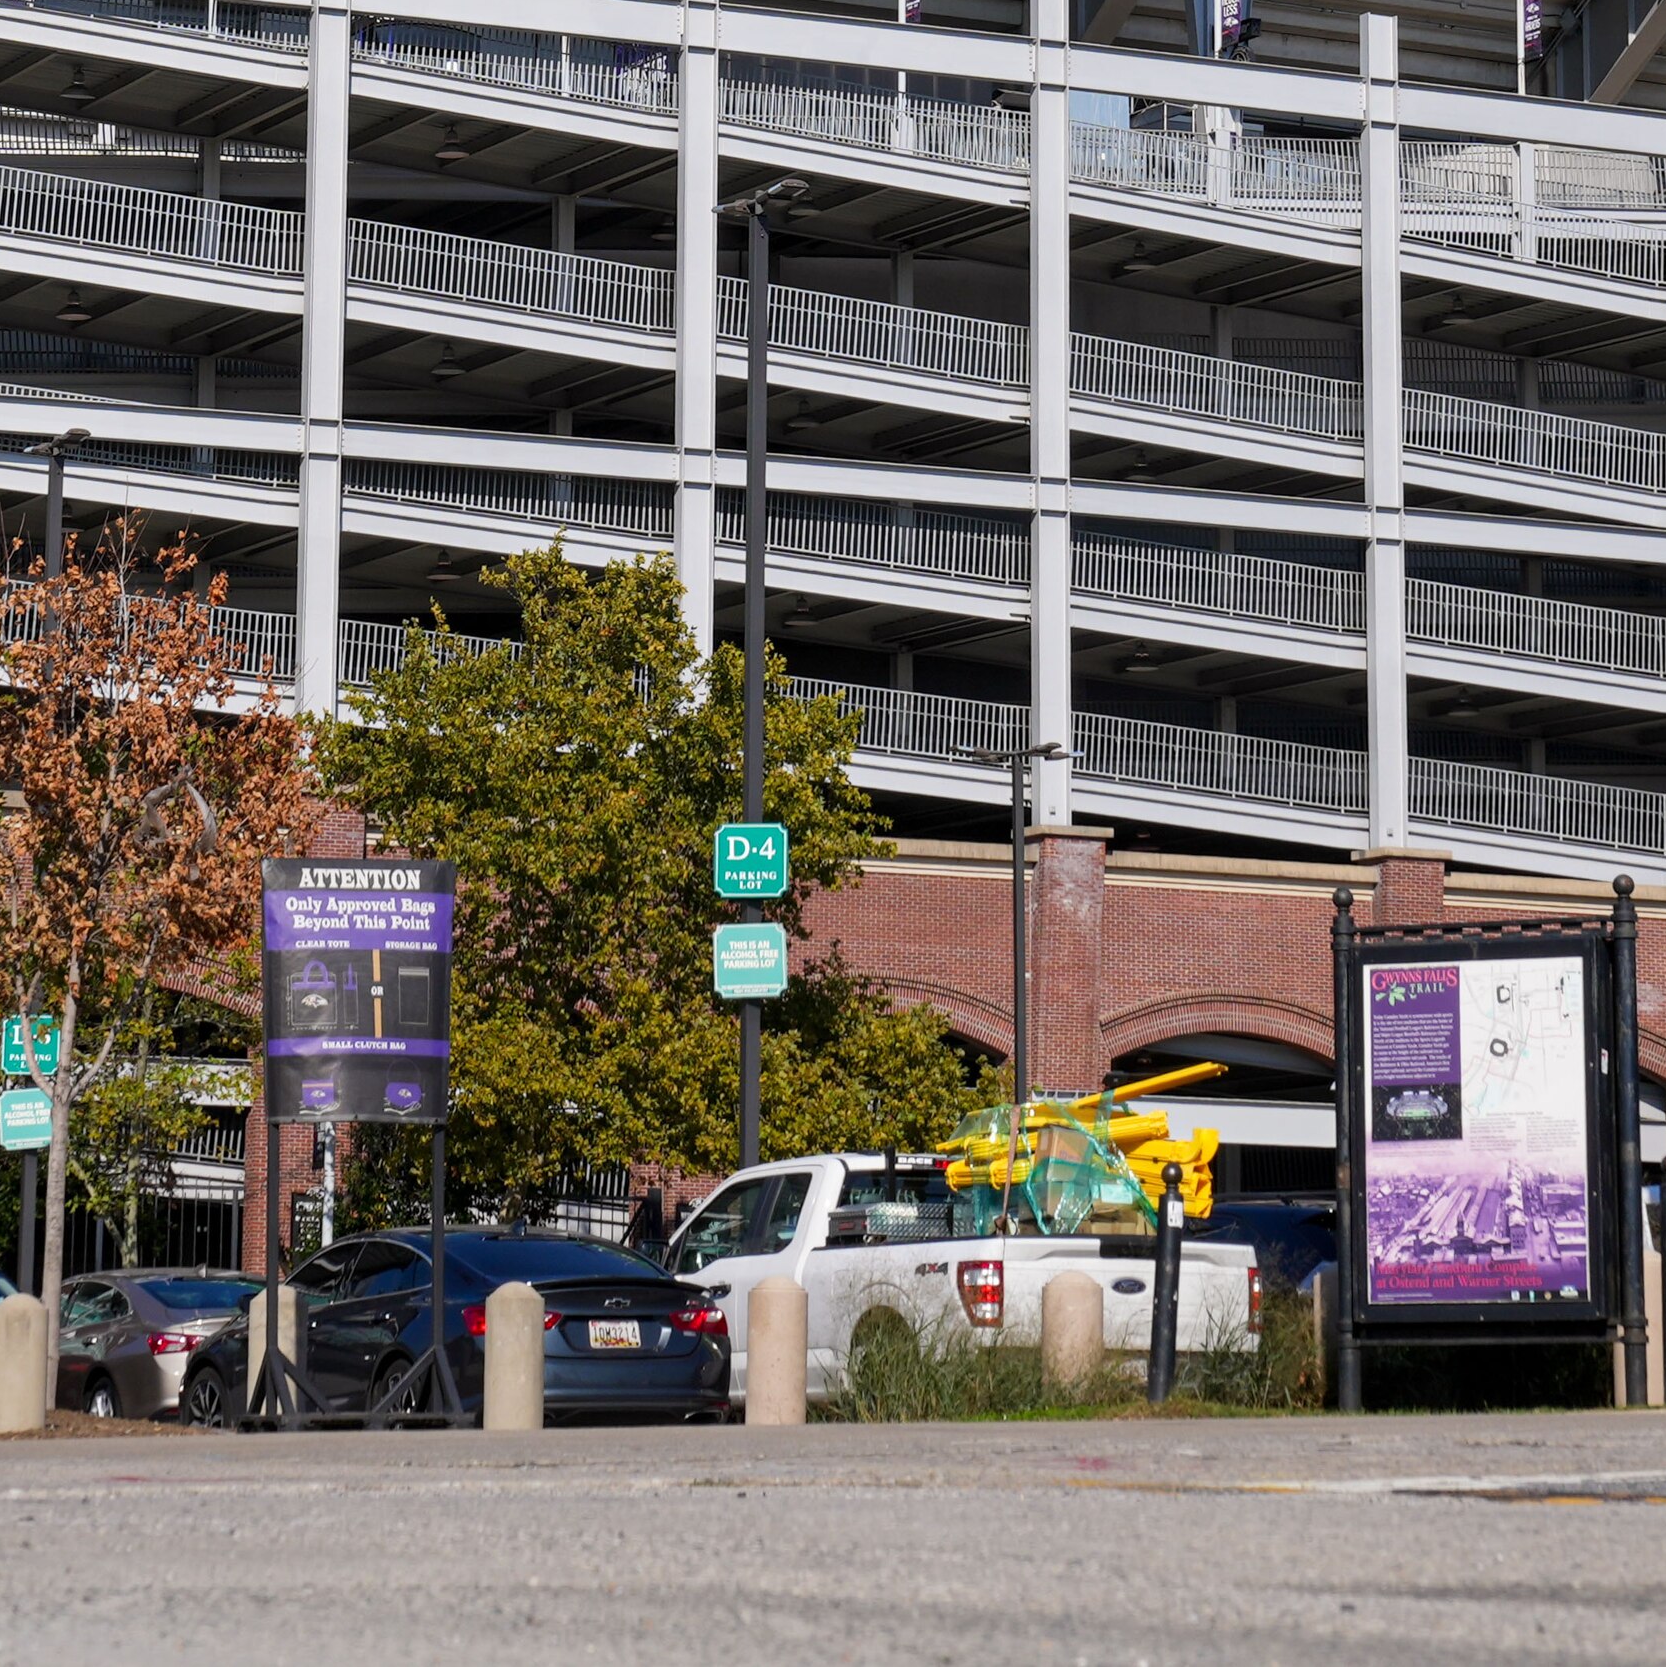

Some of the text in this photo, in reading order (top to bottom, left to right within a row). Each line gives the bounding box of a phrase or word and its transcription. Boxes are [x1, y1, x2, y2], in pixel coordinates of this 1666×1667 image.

[299, 867, 421, 890] ATTENTION
[724, 871, 777, 881] PARKING
[739, 881, 762, 890] LOT
[285, 897, 436, 915] Only Approved Bags
[293, 914, 430, 931] Beyond This Point
[295, 940, 350, 949] CLEAR TOTE
[385, 940, 438, 951] STORAGE BAG
[729, 940, 770, 950] THIS IS AN
[721, 949, 779, 960] ALCOHOL FREE
[724, 959, 776, 969] PARKING LOT
[1372, 968, 1457, 990] GWYNNS FALLS
[371, 986, 384, 996] OR
[1410, 983, 1445, 993] TRAIL
[322, 1041, 406, 1051] SMALL CLUTCH BAG
[898, 1157, 933, 1165] BACK
[1389, 1275, 1429, 1289] Ostend
[1432, 1275, 1454, 1288] and
